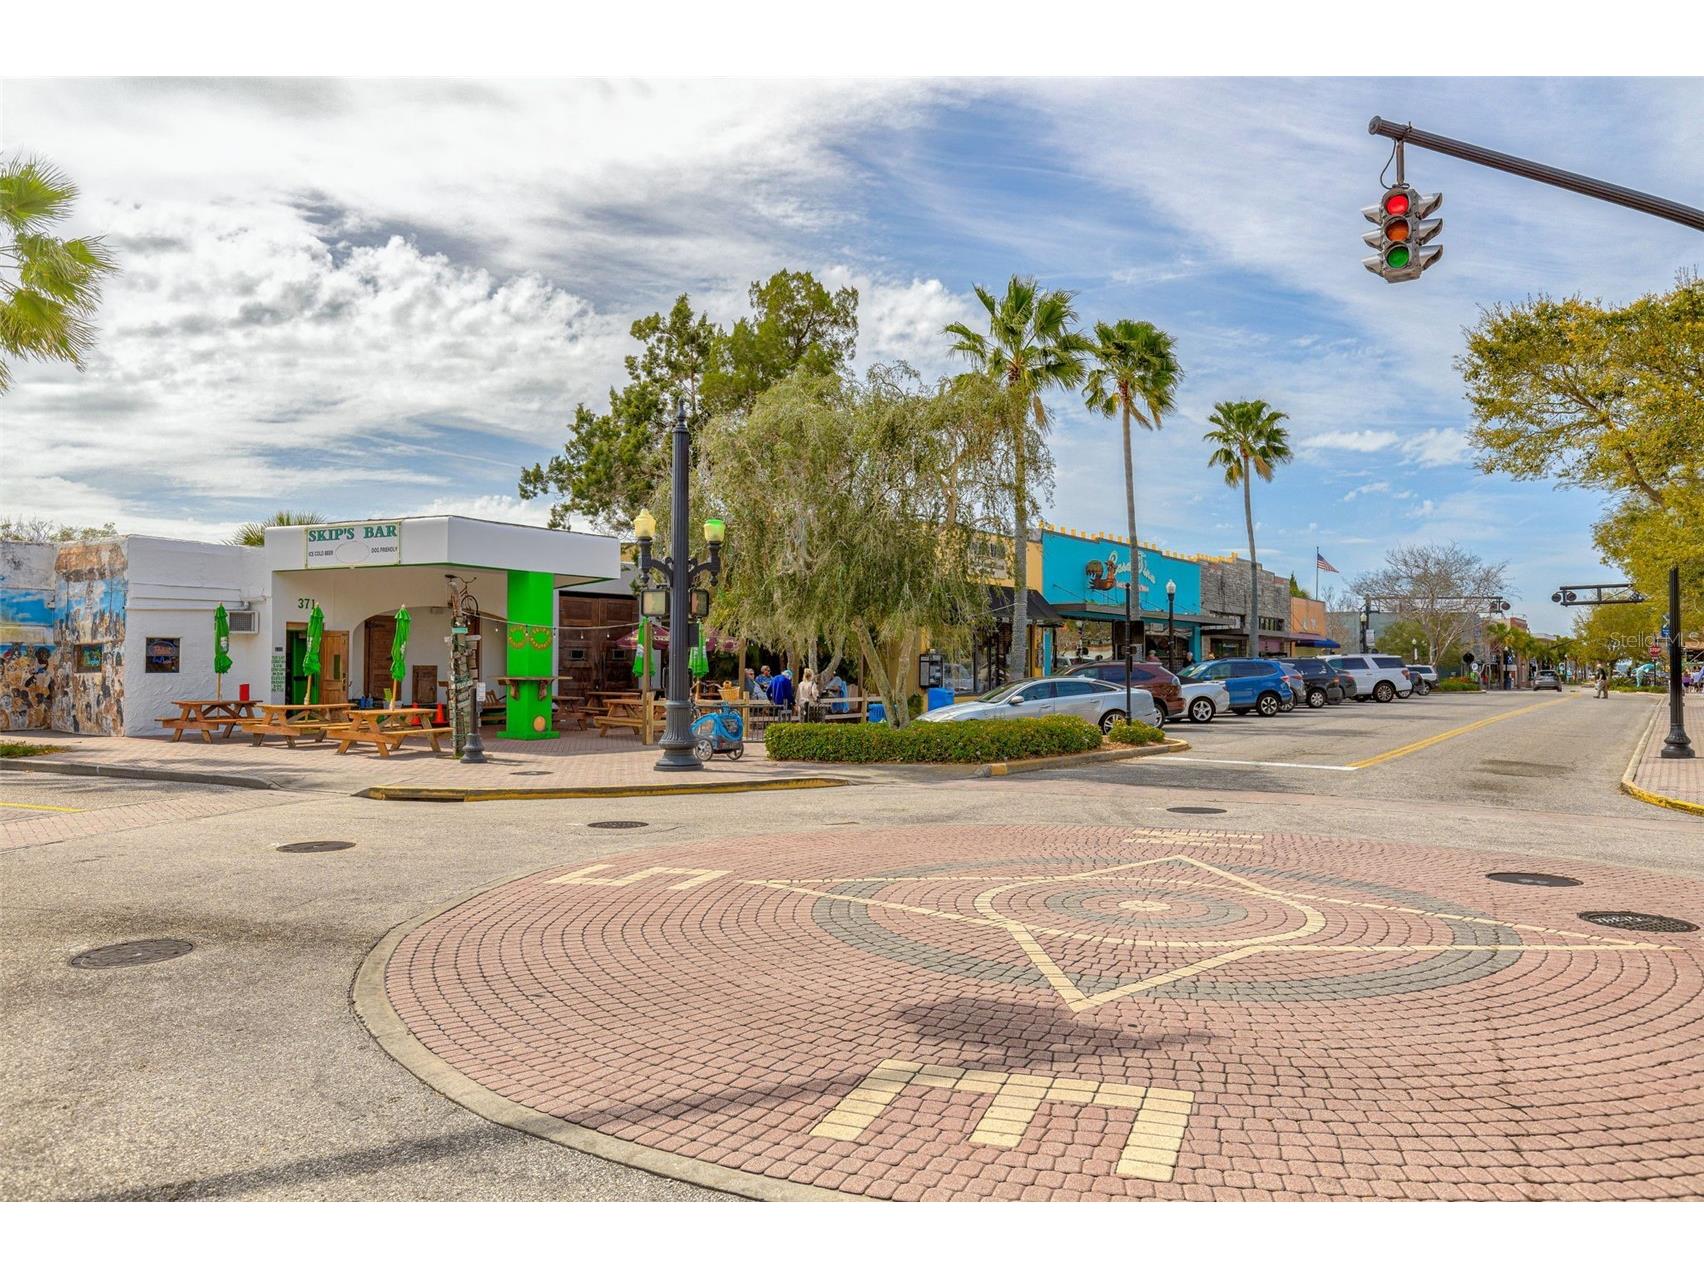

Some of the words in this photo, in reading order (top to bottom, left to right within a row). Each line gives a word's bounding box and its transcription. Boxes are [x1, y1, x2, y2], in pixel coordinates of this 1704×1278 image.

[308, 527, 355, 542] SKIP'S
[363, 525, 398, 539] BAR
[298, 598, 315, 609] 371
[808, 1058, 1195, 1182] E
